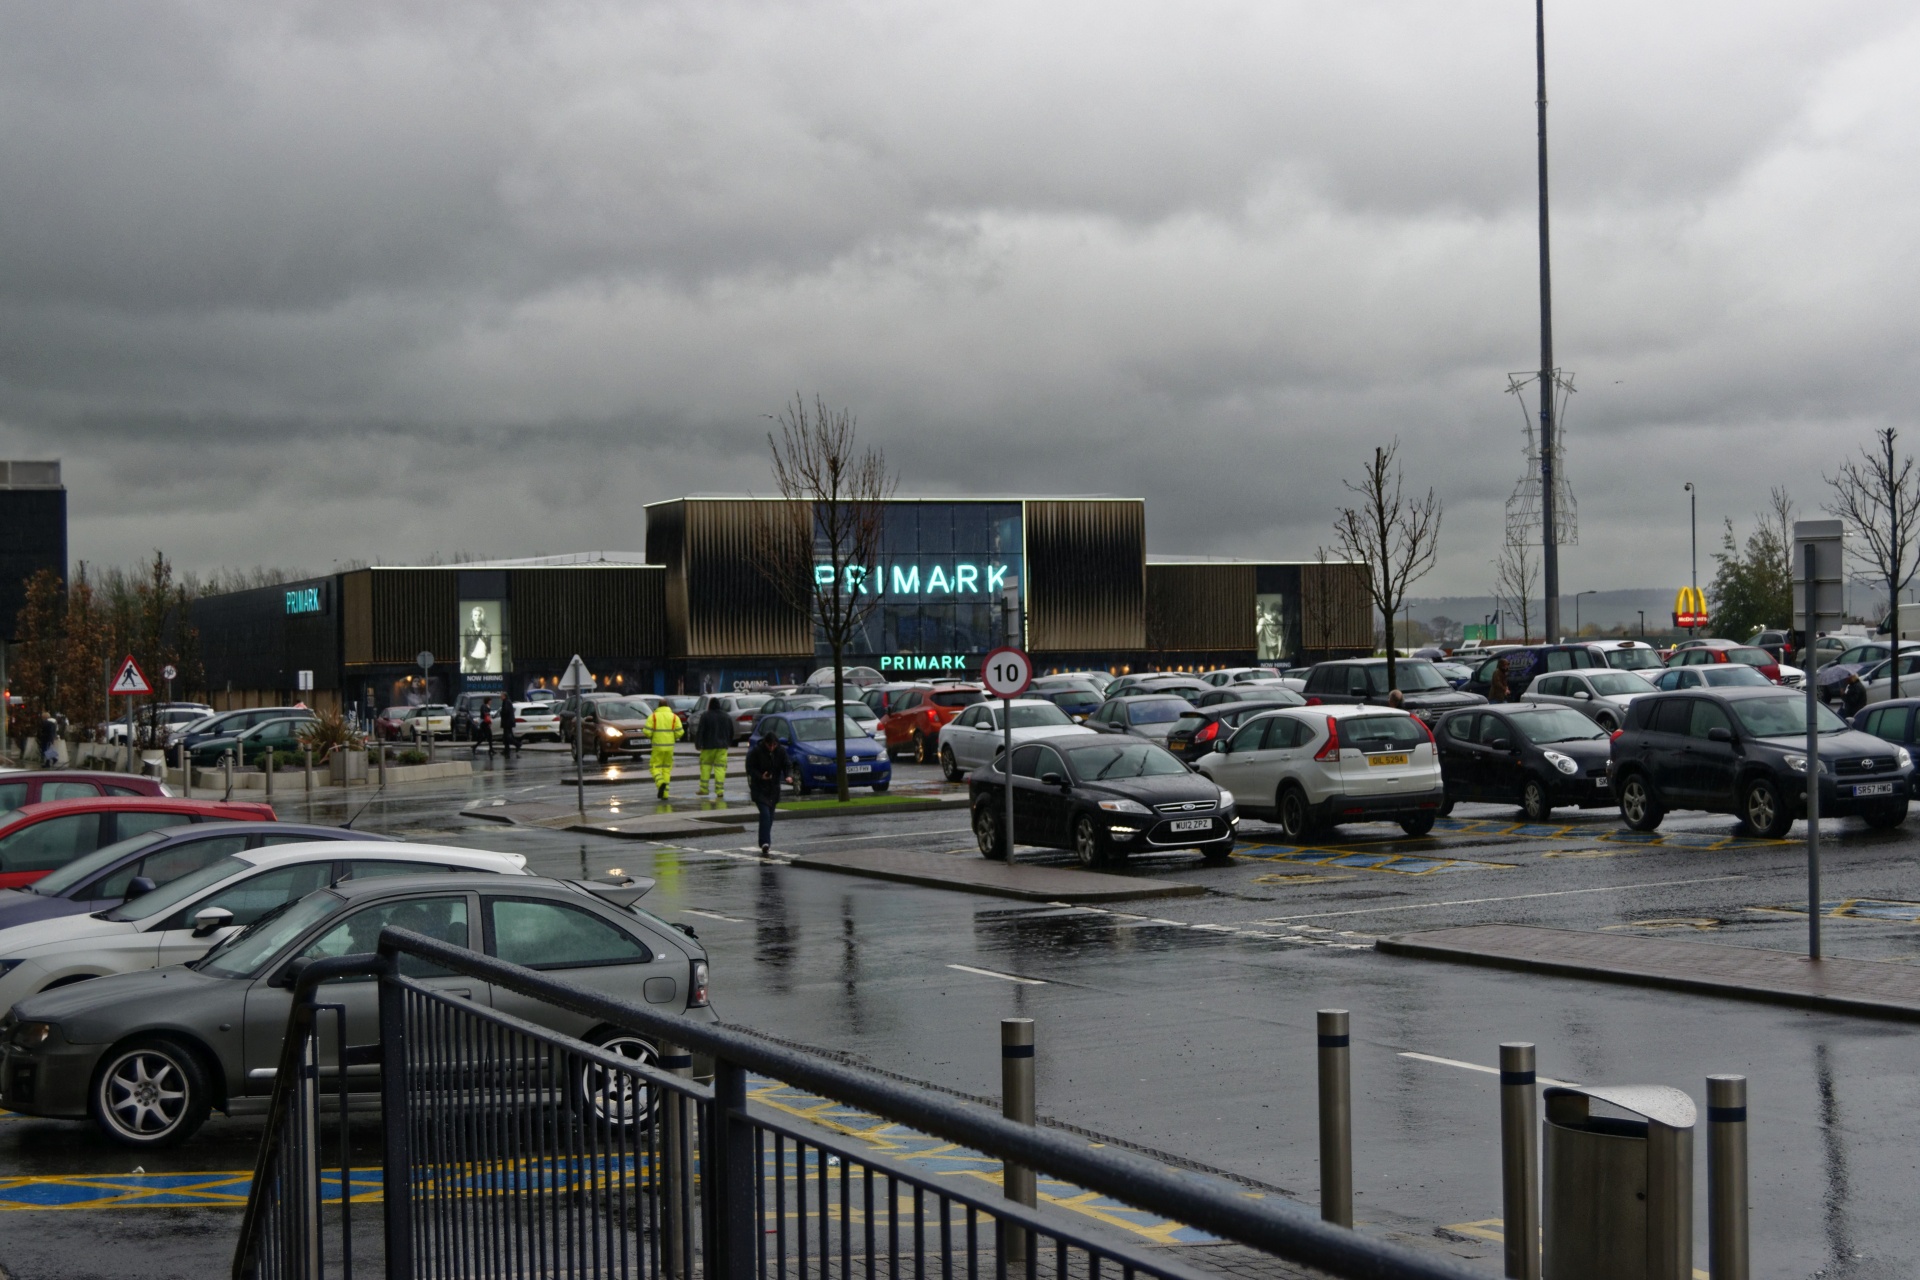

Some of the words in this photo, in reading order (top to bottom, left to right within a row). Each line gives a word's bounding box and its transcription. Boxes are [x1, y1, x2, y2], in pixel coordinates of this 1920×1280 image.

[815, 565, 1008, 594] PRIMARK
[286, 587, 319, 614] PRIMARK
[880, 655, 966, 671] PRIMARK
[993, 664, 1019, 682] 10
[1385, 755, 1404, 764] 5294
[1858, 785, 1876, 794] SR57
[1176, 821, 1192, 830] WU12
[1193, 820, 1208, 829] ZPZ
